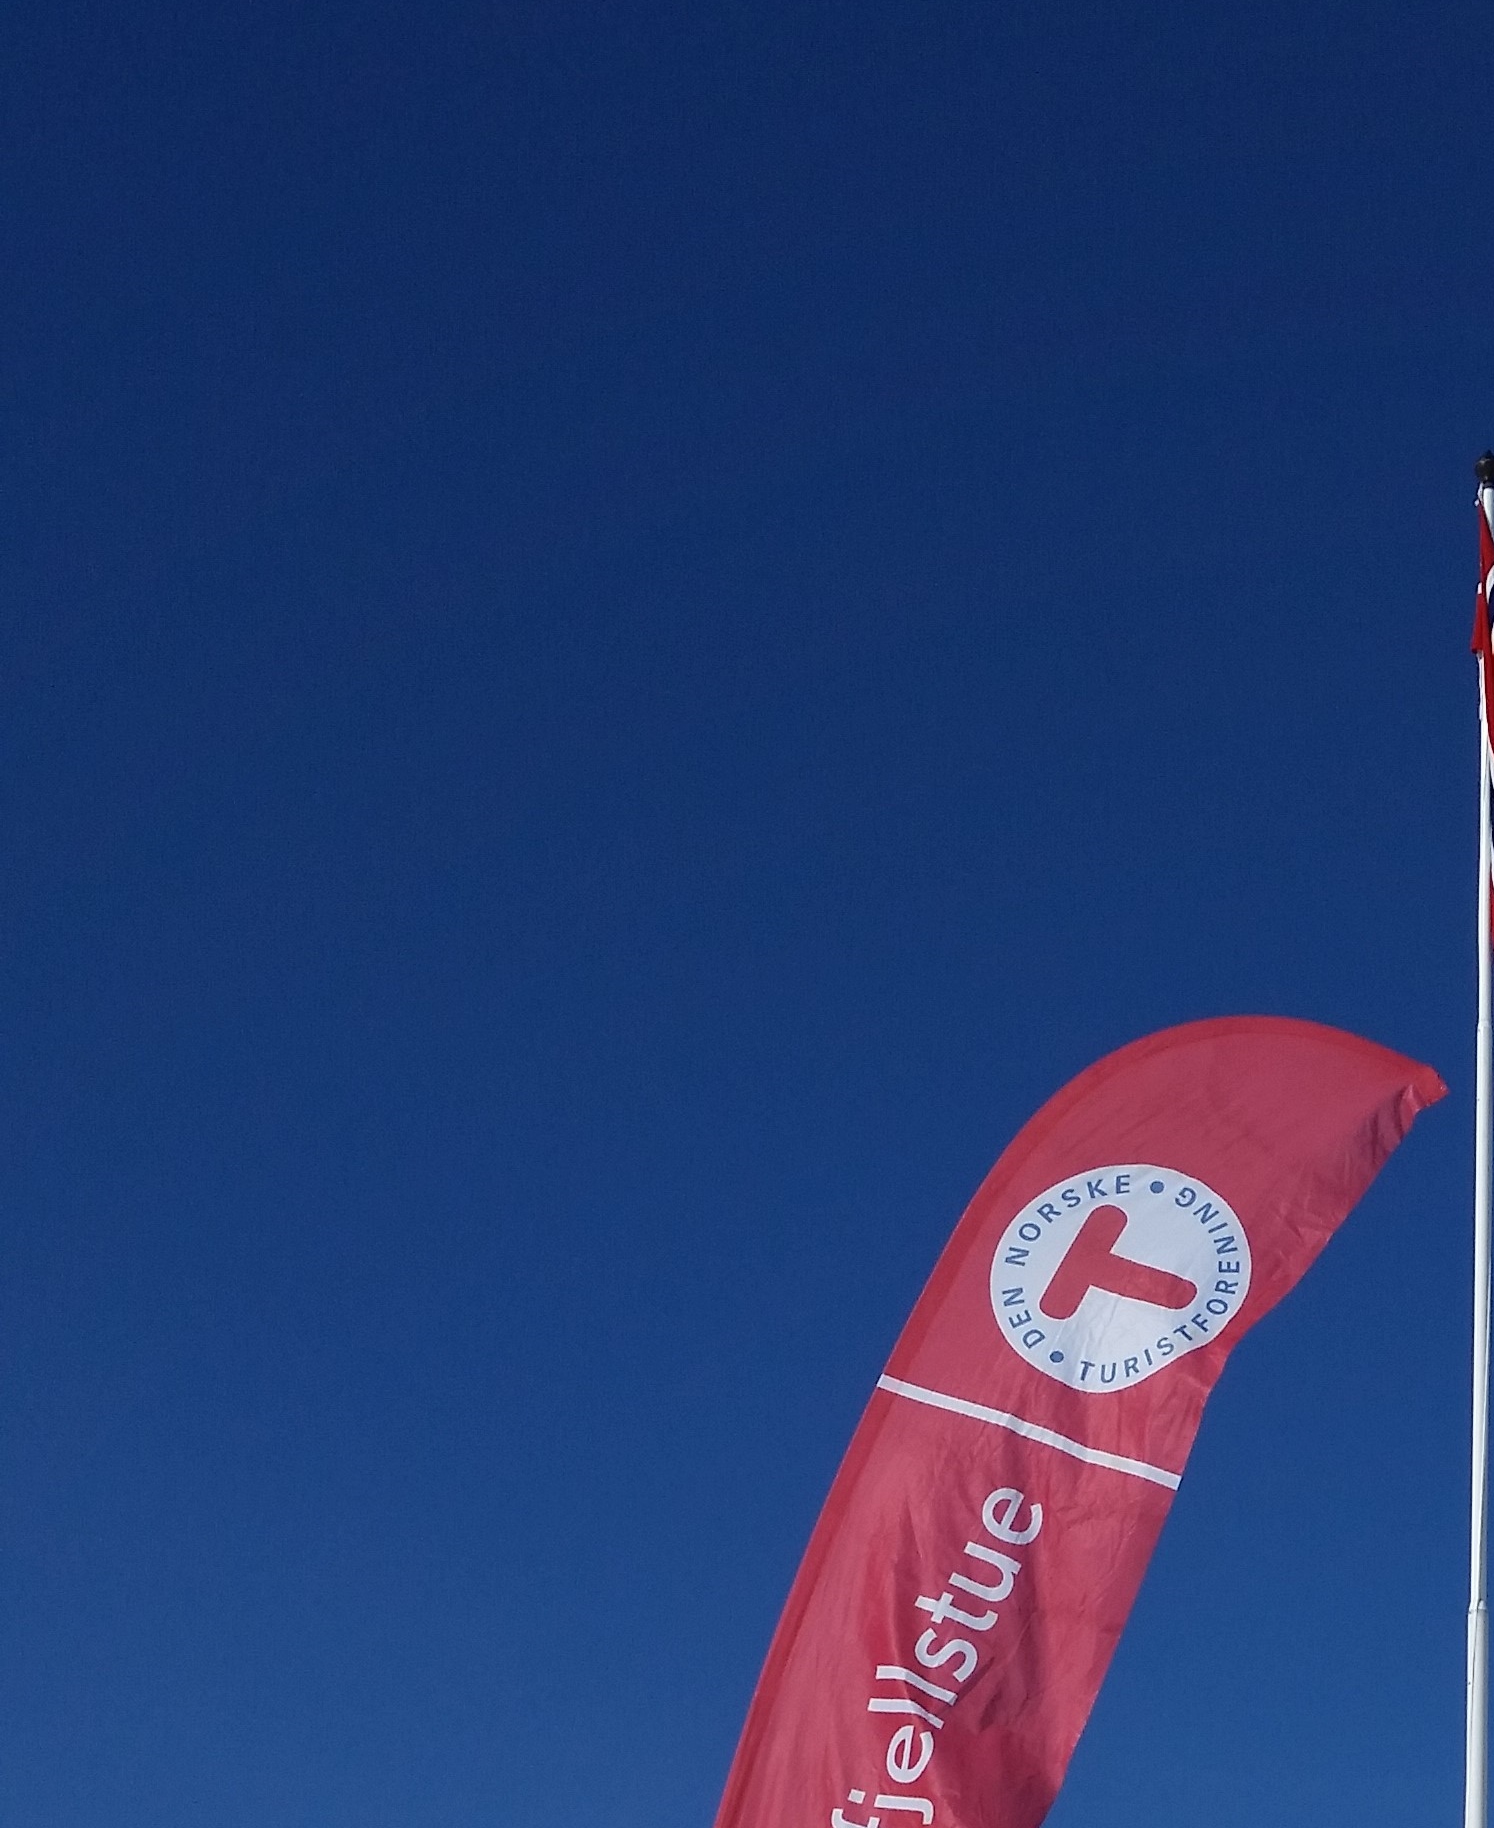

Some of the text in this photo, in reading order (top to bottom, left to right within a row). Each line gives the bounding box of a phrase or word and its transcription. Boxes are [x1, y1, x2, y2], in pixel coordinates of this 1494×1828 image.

[1001, 1173, 1131, 1350] DEN NORSKE
[1078, 1186, 1240, 1383] TURISTFORENING
